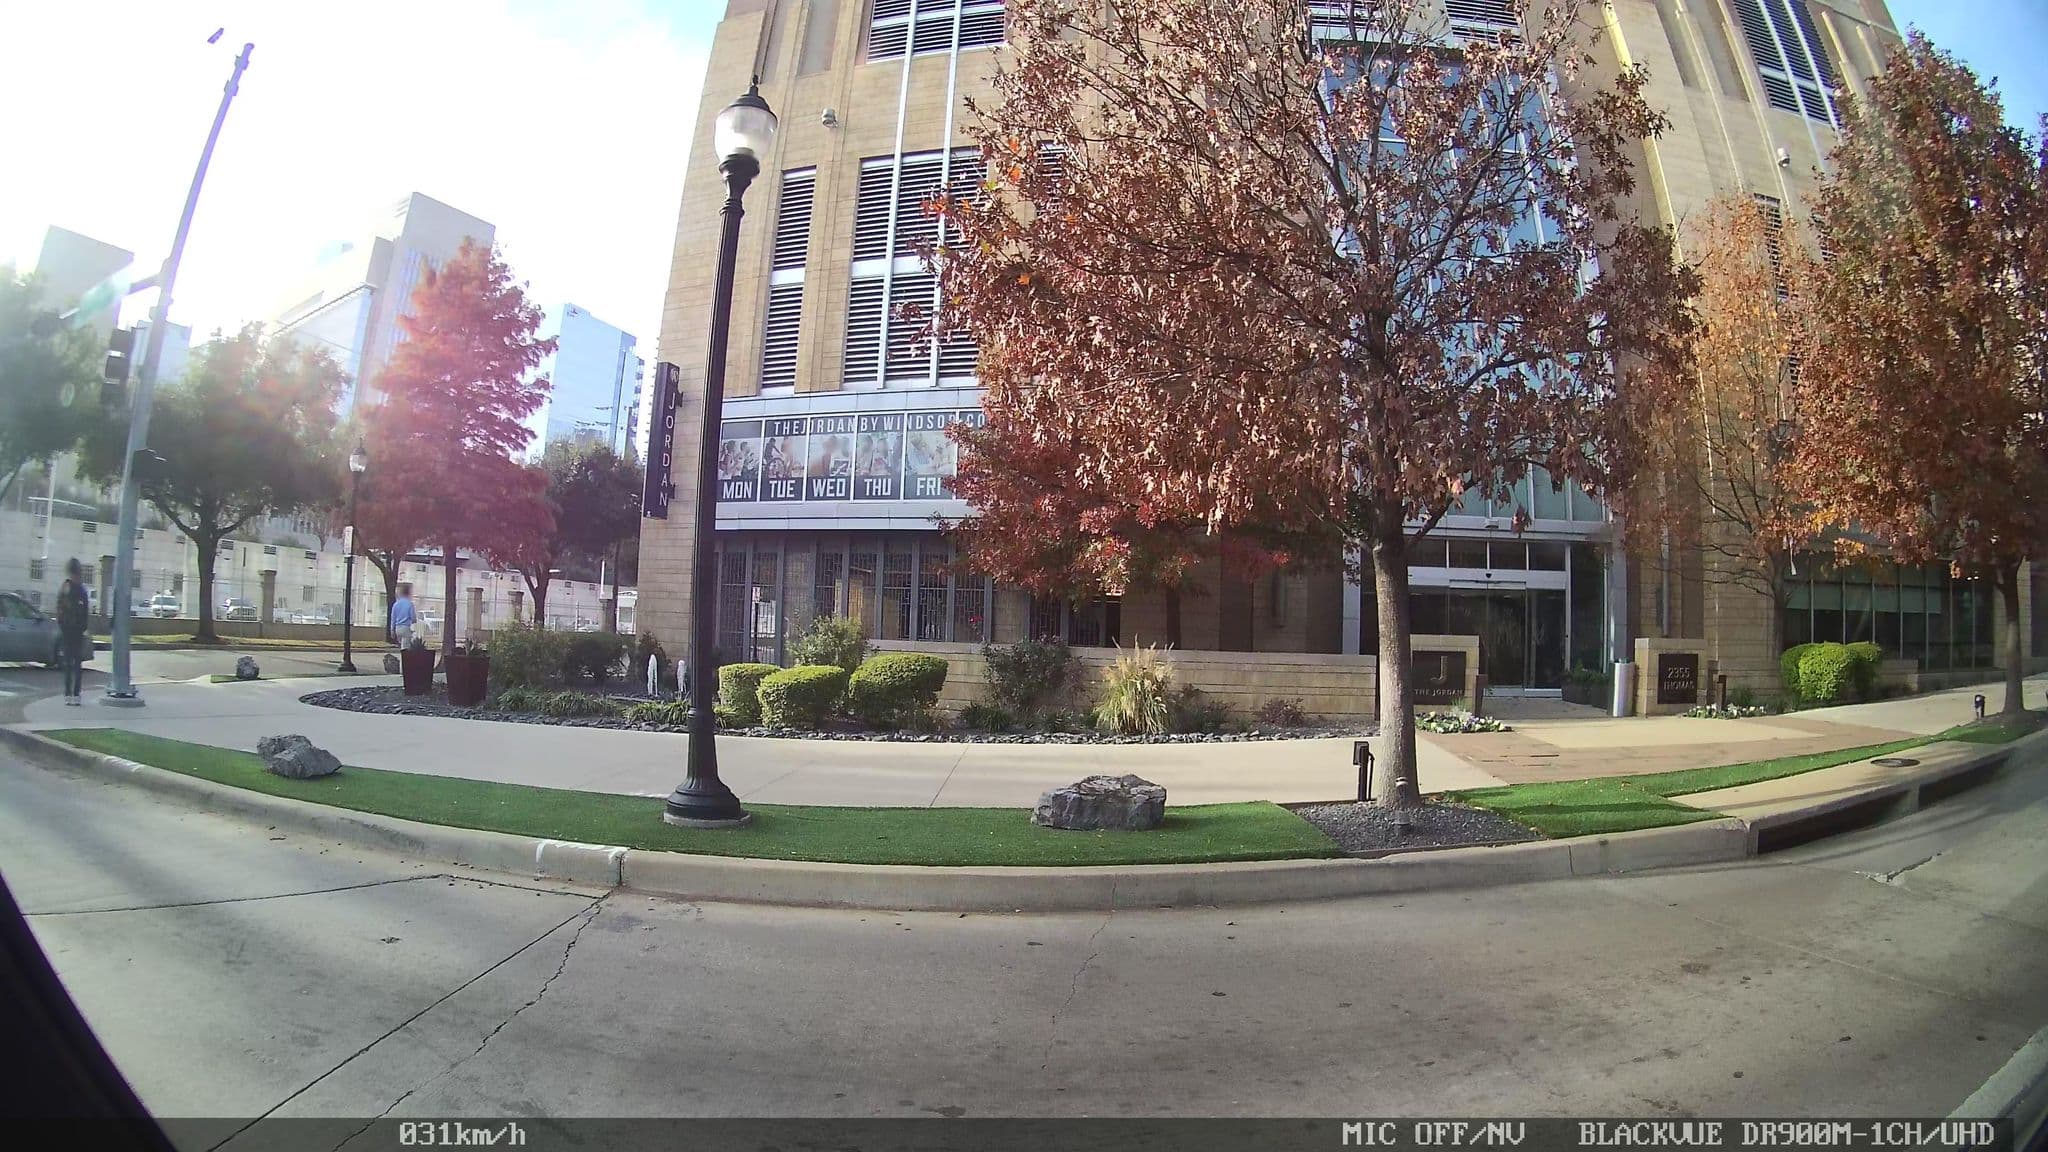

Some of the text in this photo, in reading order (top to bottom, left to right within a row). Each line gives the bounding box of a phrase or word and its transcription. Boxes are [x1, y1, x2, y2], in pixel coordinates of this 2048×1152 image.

[659, 392, 677, 507] JORDAN
[722, 481, 753, 499] MON
[769, 479, 796, 498] TUE
[812, 478, 846, 497] WED
[863, 478, 892, 496] THU
[916, 477, 941, 496] FRI
[1667, 667, 1691, 679] 2355
[1414, 688, 1463, 697] THE JORDAN
[1664, 681, 1695, 691] THOMAS
